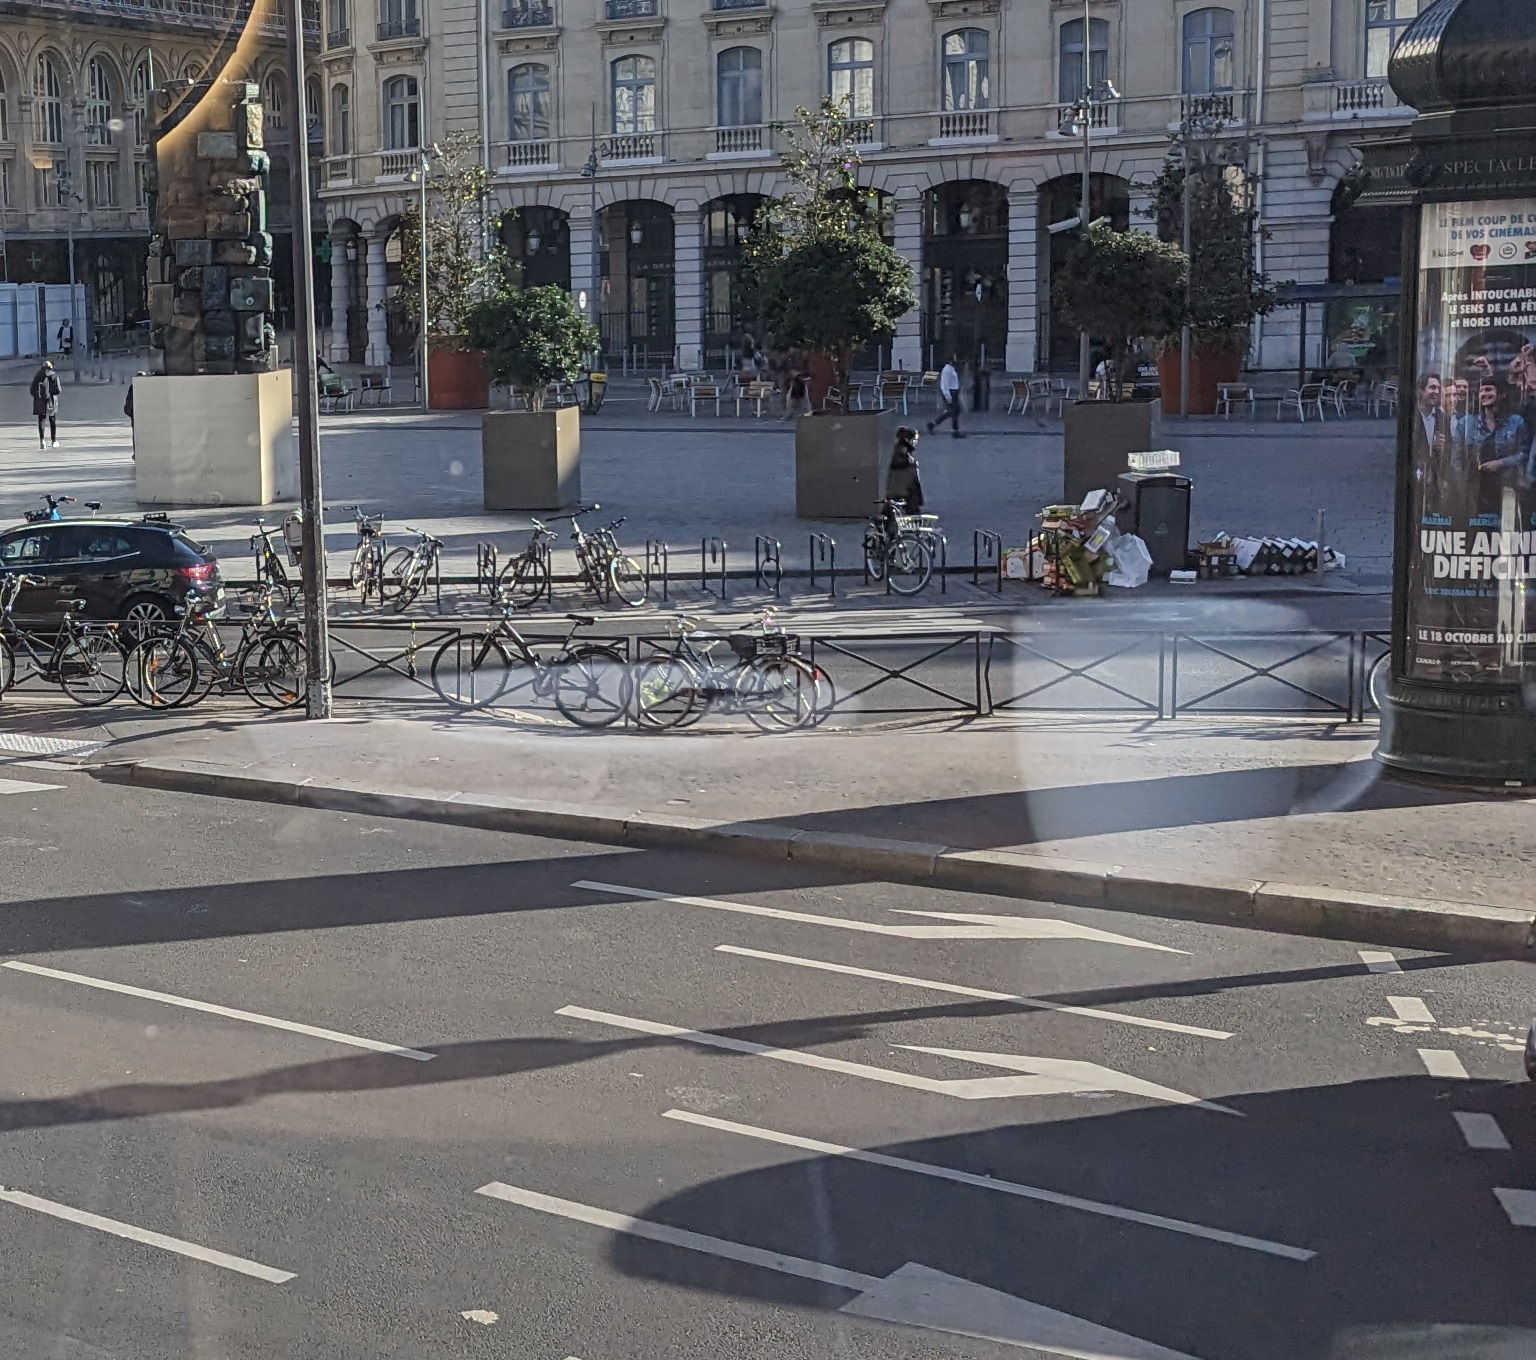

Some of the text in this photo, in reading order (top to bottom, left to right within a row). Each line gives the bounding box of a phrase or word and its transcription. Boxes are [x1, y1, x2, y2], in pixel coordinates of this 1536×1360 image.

[1443, 156, 1536, 175] SPECTACLE
[1451, 216, 1474, 227] FILM
[1477, 215, 1507, 226] COUP
[1510, 214, 1524, 224] DE
[1451, 230, 1463, 240] DE
[1466, 229, 1485, 239] VOS
[1441, 288, 1536, 303] Après INTOUCHABL
[1449, 304, 1458, 315] LE
[1460, 303, 1484, 314] SENS
[1487, 302, 1501, 313] DE
[1504, 302, 1517, 313] LA
[1451, 315, 1536, 328] et HORS NORME
[1420, 529, 1536, 555] UNE ANN
[1418, 629, 1428, 641] LE
[1430, 631, 1443, 642] 18
[1444, 632, 1495, 643] OCTOBRE
[1496, 633, 1514, 644] AU
